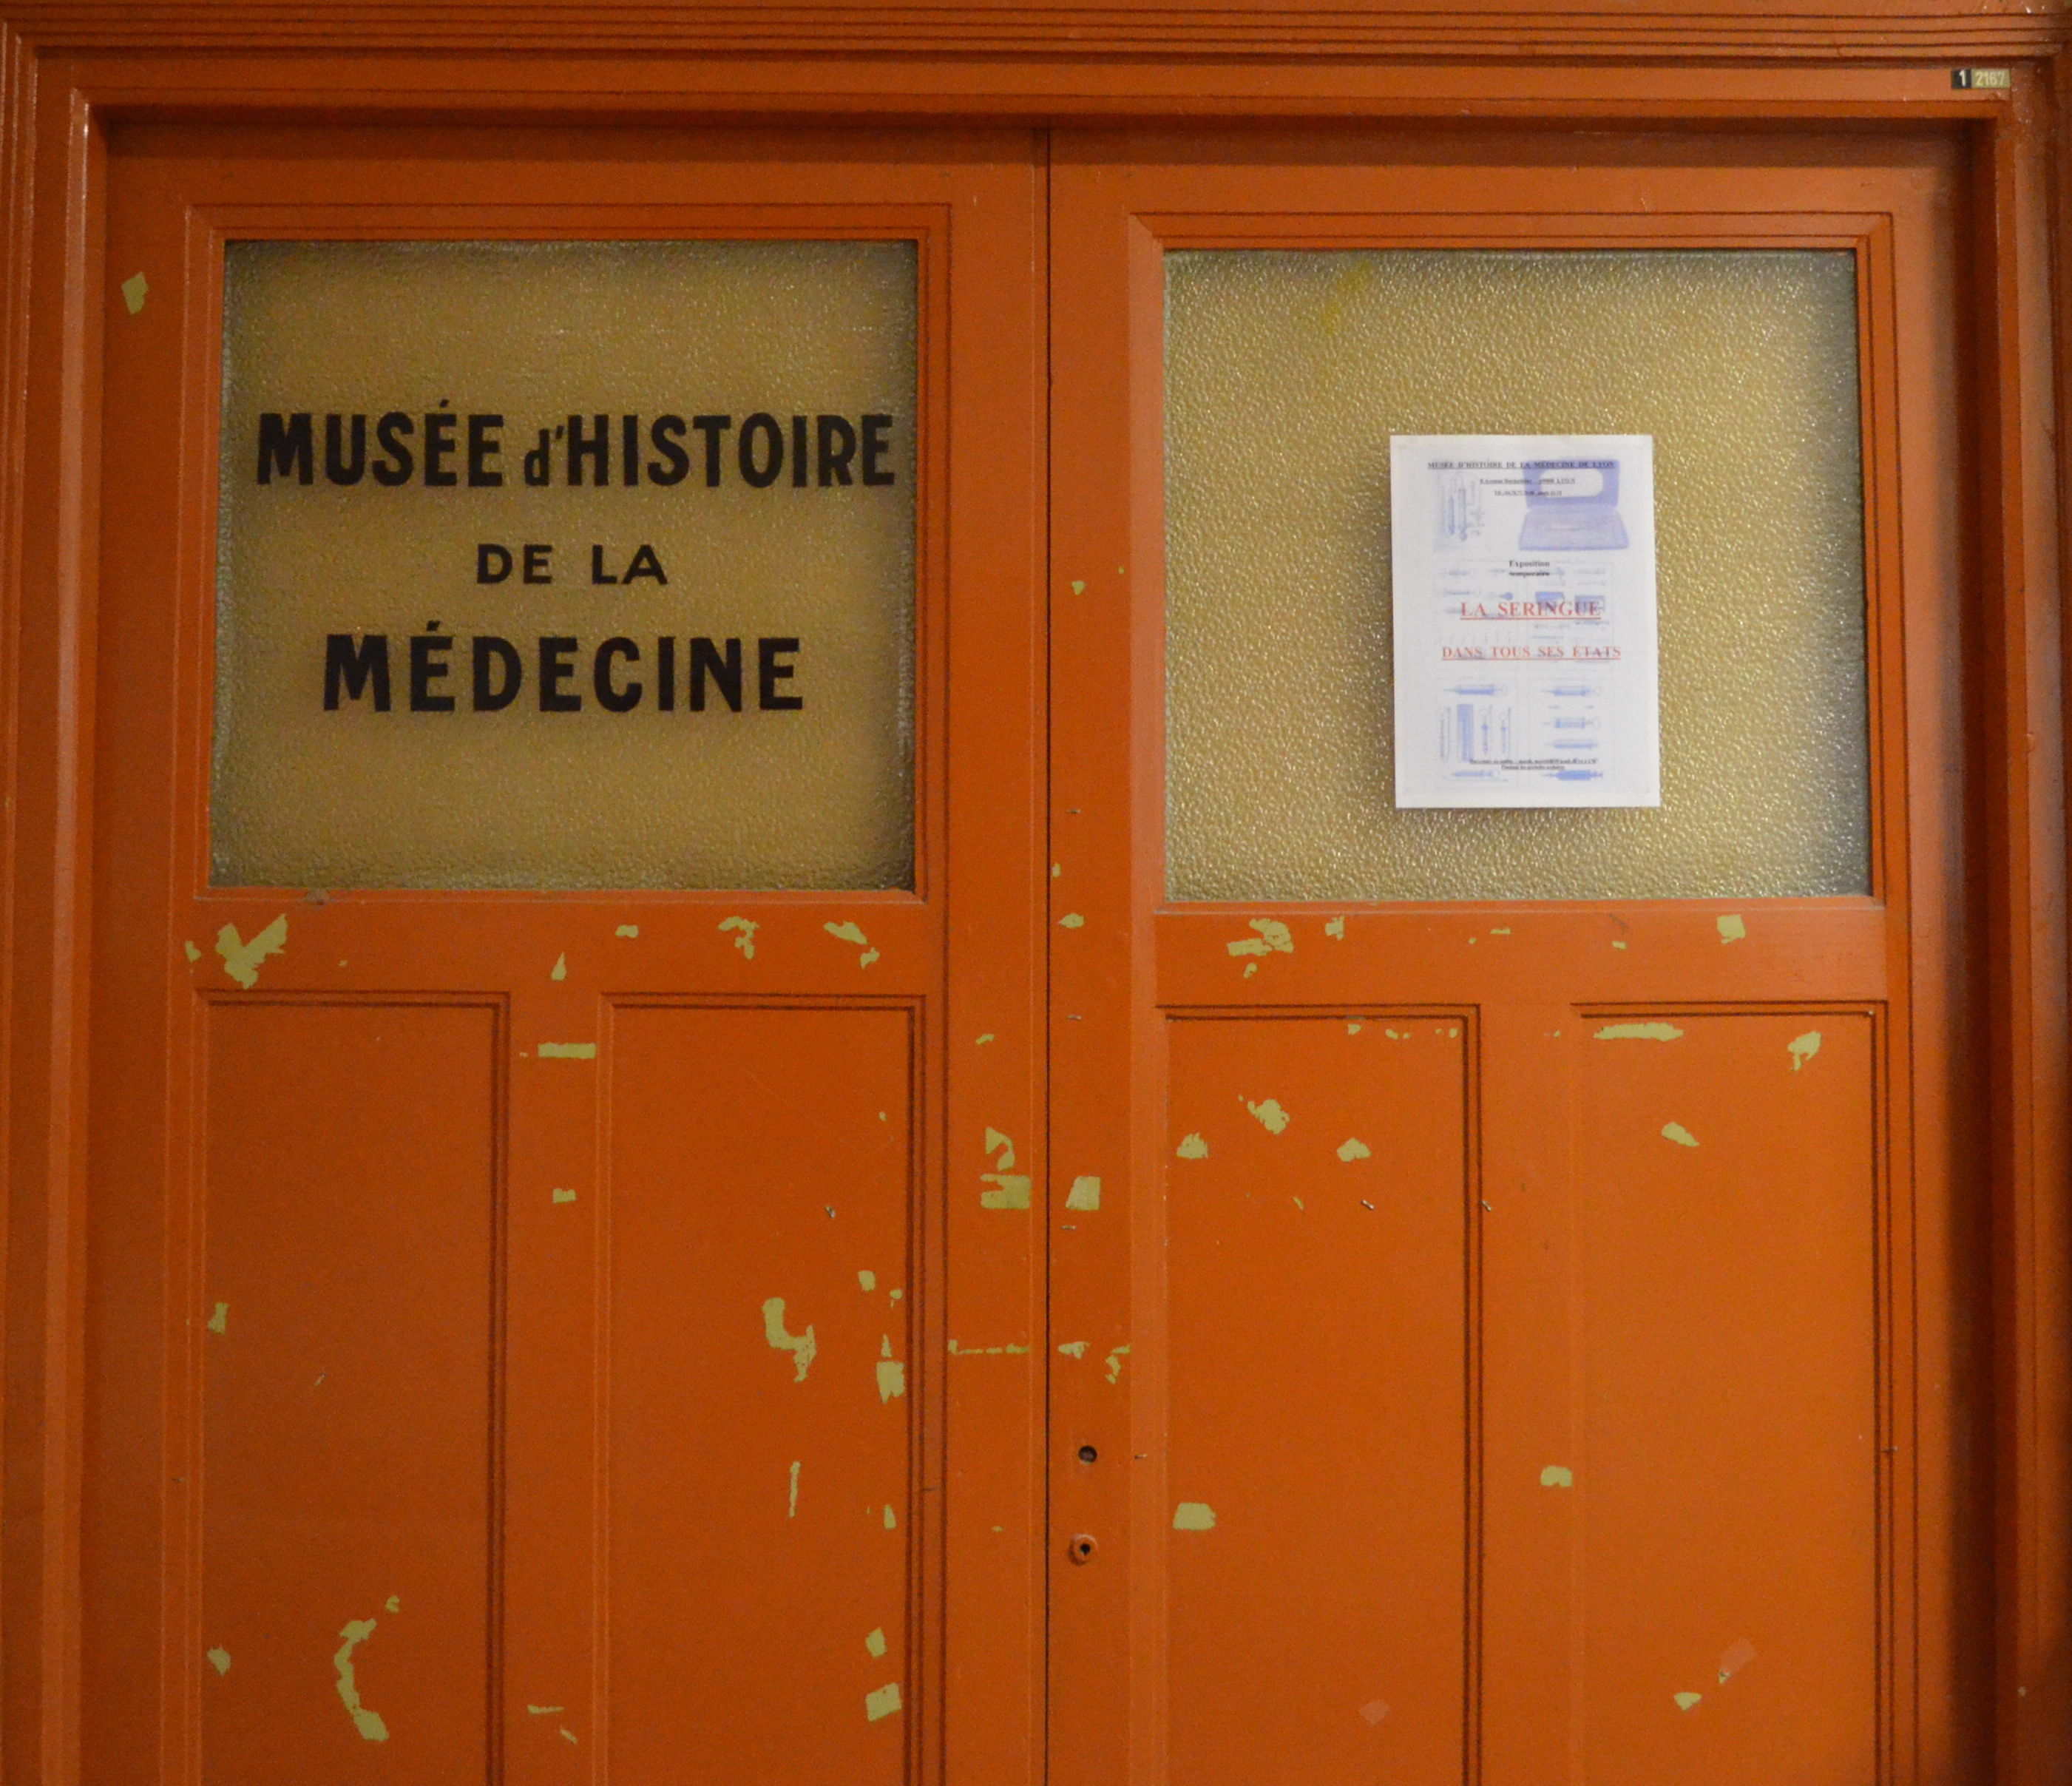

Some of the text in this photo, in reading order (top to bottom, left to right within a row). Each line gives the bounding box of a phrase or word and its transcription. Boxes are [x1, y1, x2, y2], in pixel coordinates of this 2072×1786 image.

[1959, 70, 2005, 87] 1 2167
[257, 400, 896, 488] MUSÉE d'HISTOIRE
[476, 544, 668, 585] DE LA
[1509, 560, 1551, 568] Exposition
[1460, 601, 1602, 617] LA SERINGUE
[1442, 646, 1483, 658] DANS
[1491, 646, 1531, 657] TOUS
[1537, 646, 1565, 657] SES
[323, 621, 804, 713] MÉDECINE
